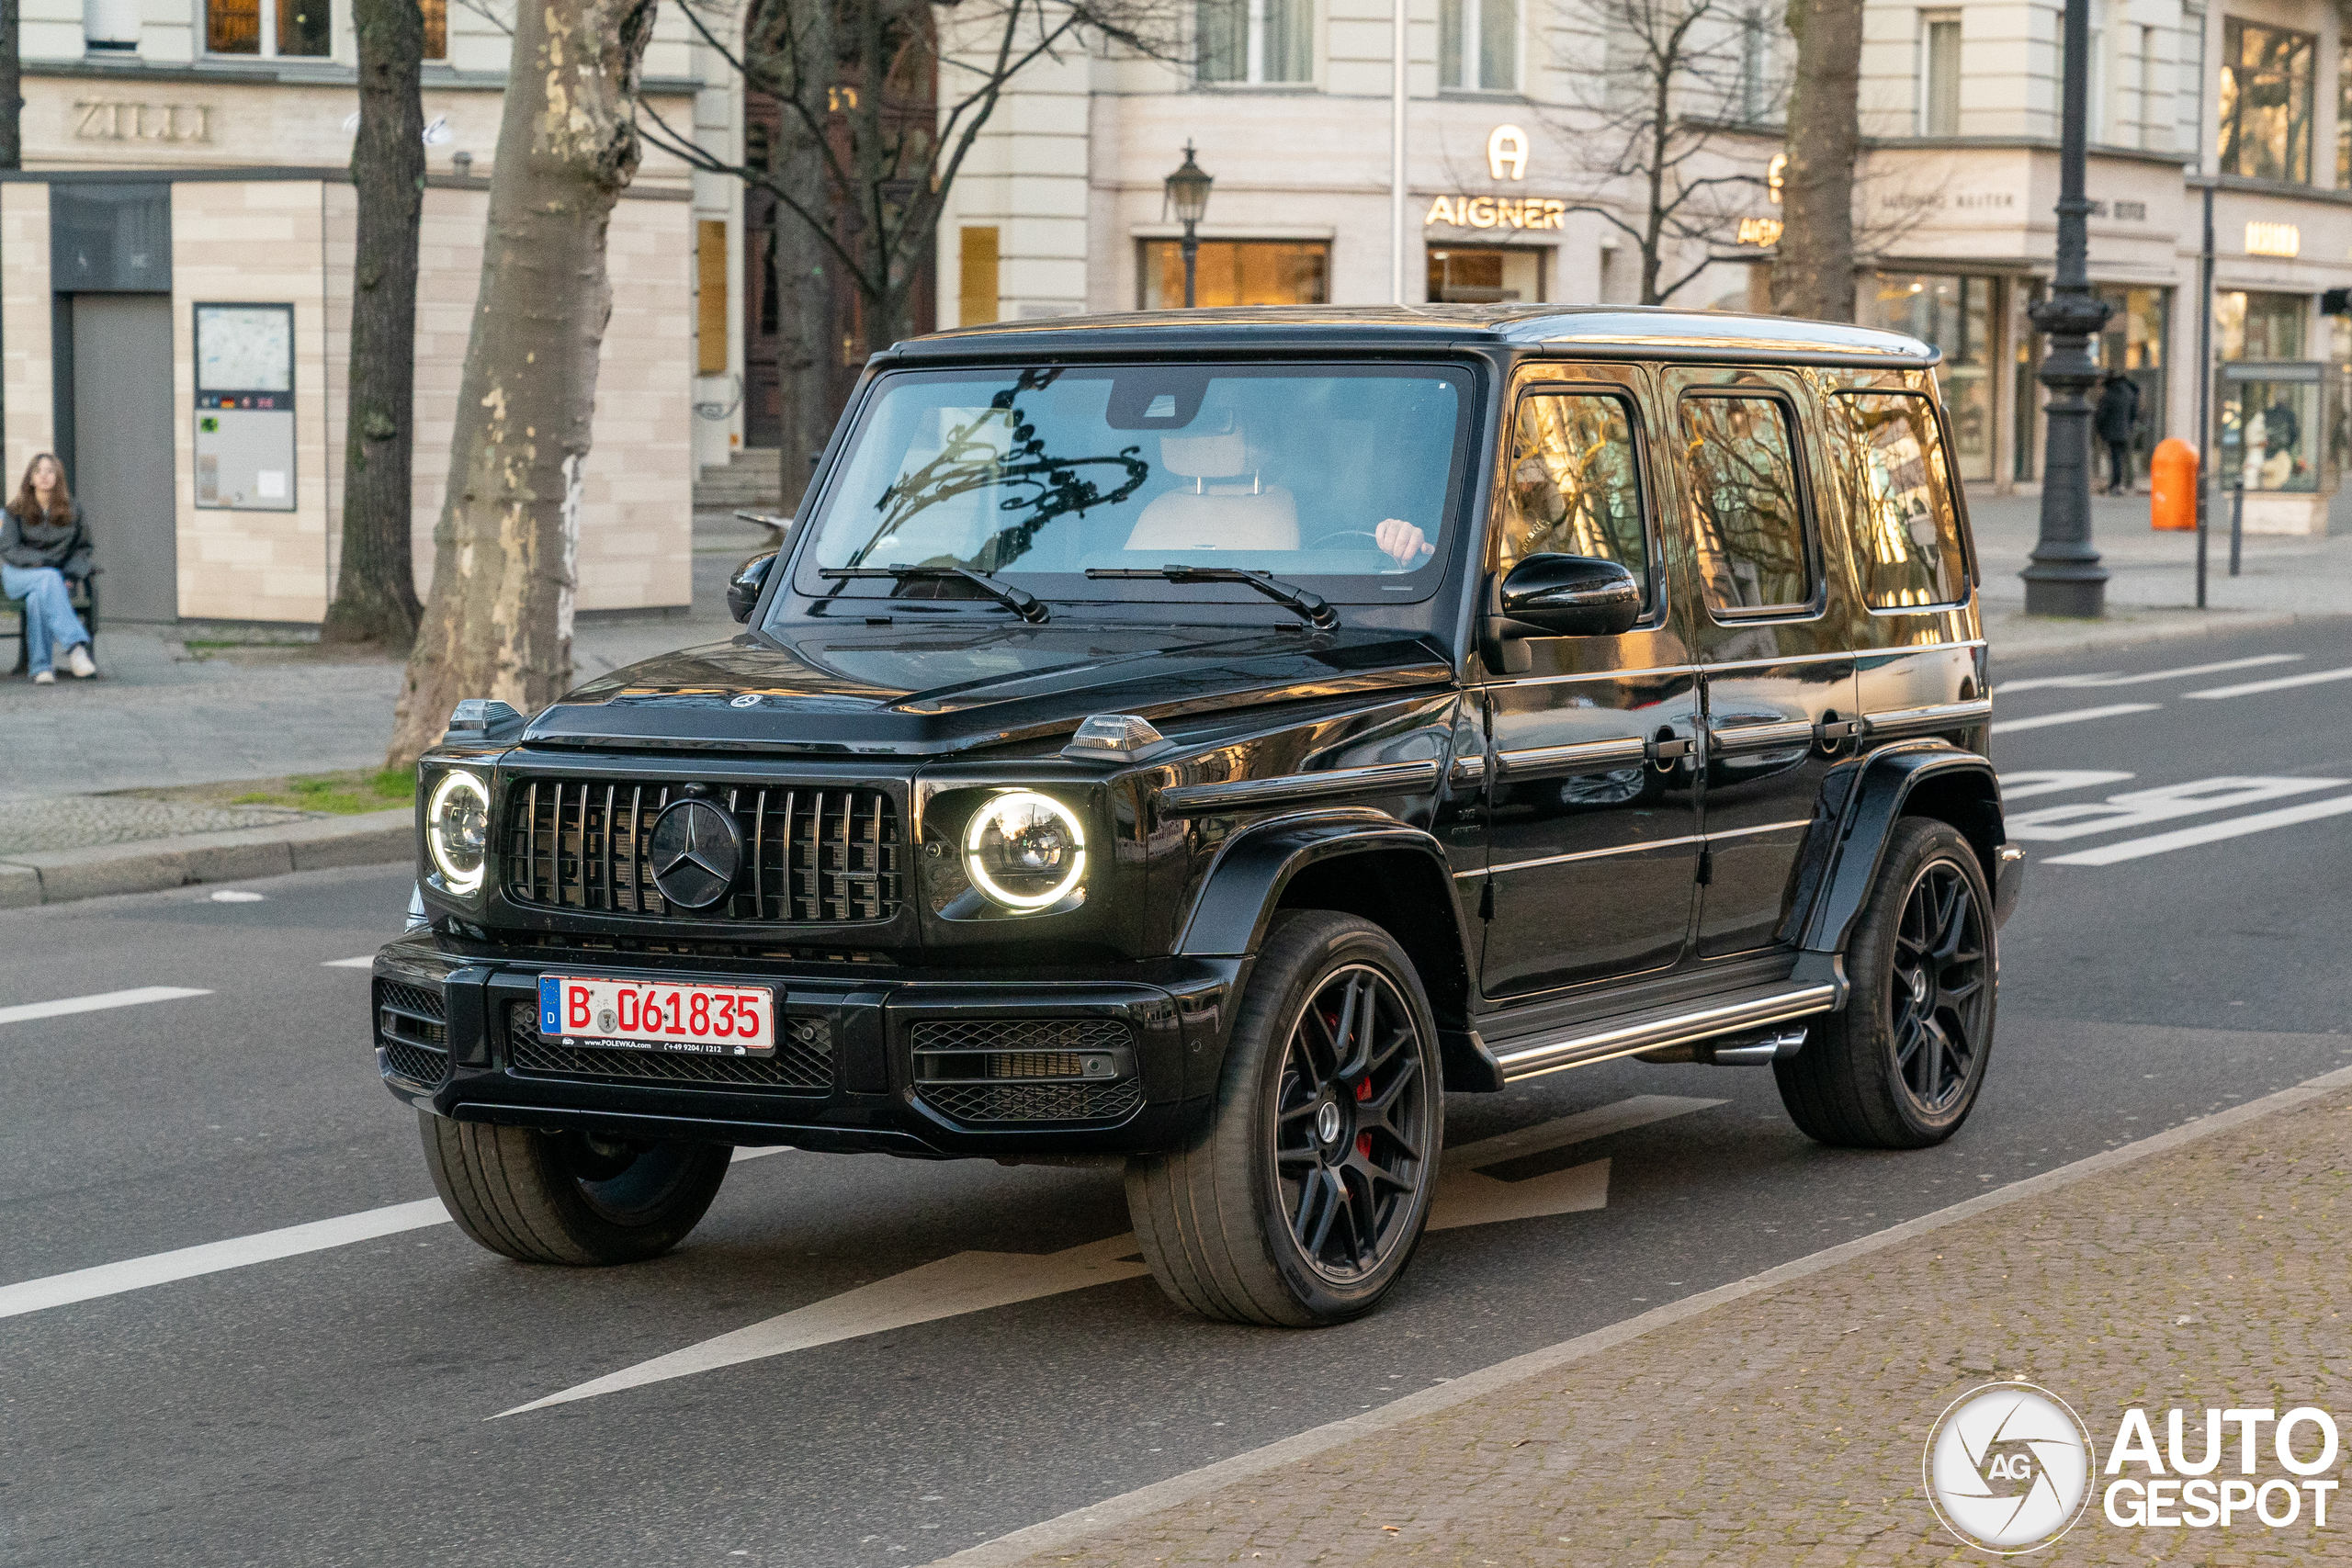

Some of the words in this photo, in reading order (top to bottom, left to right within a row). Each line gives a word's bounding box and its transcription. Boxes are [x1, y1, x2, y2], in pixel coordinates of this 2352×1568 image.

[74, 101, 214, 144] ZILLI
[1425, 195, 1566, 229] AIGNER
[547, 1012, 555, 1024] D
[568, 986, 591, 1028] B
[617, 989, 759, 1038] 061835
[584, 1039, 651, 1049] www.POLEWKA.com
[668, 1043, 682, 1051] +49
